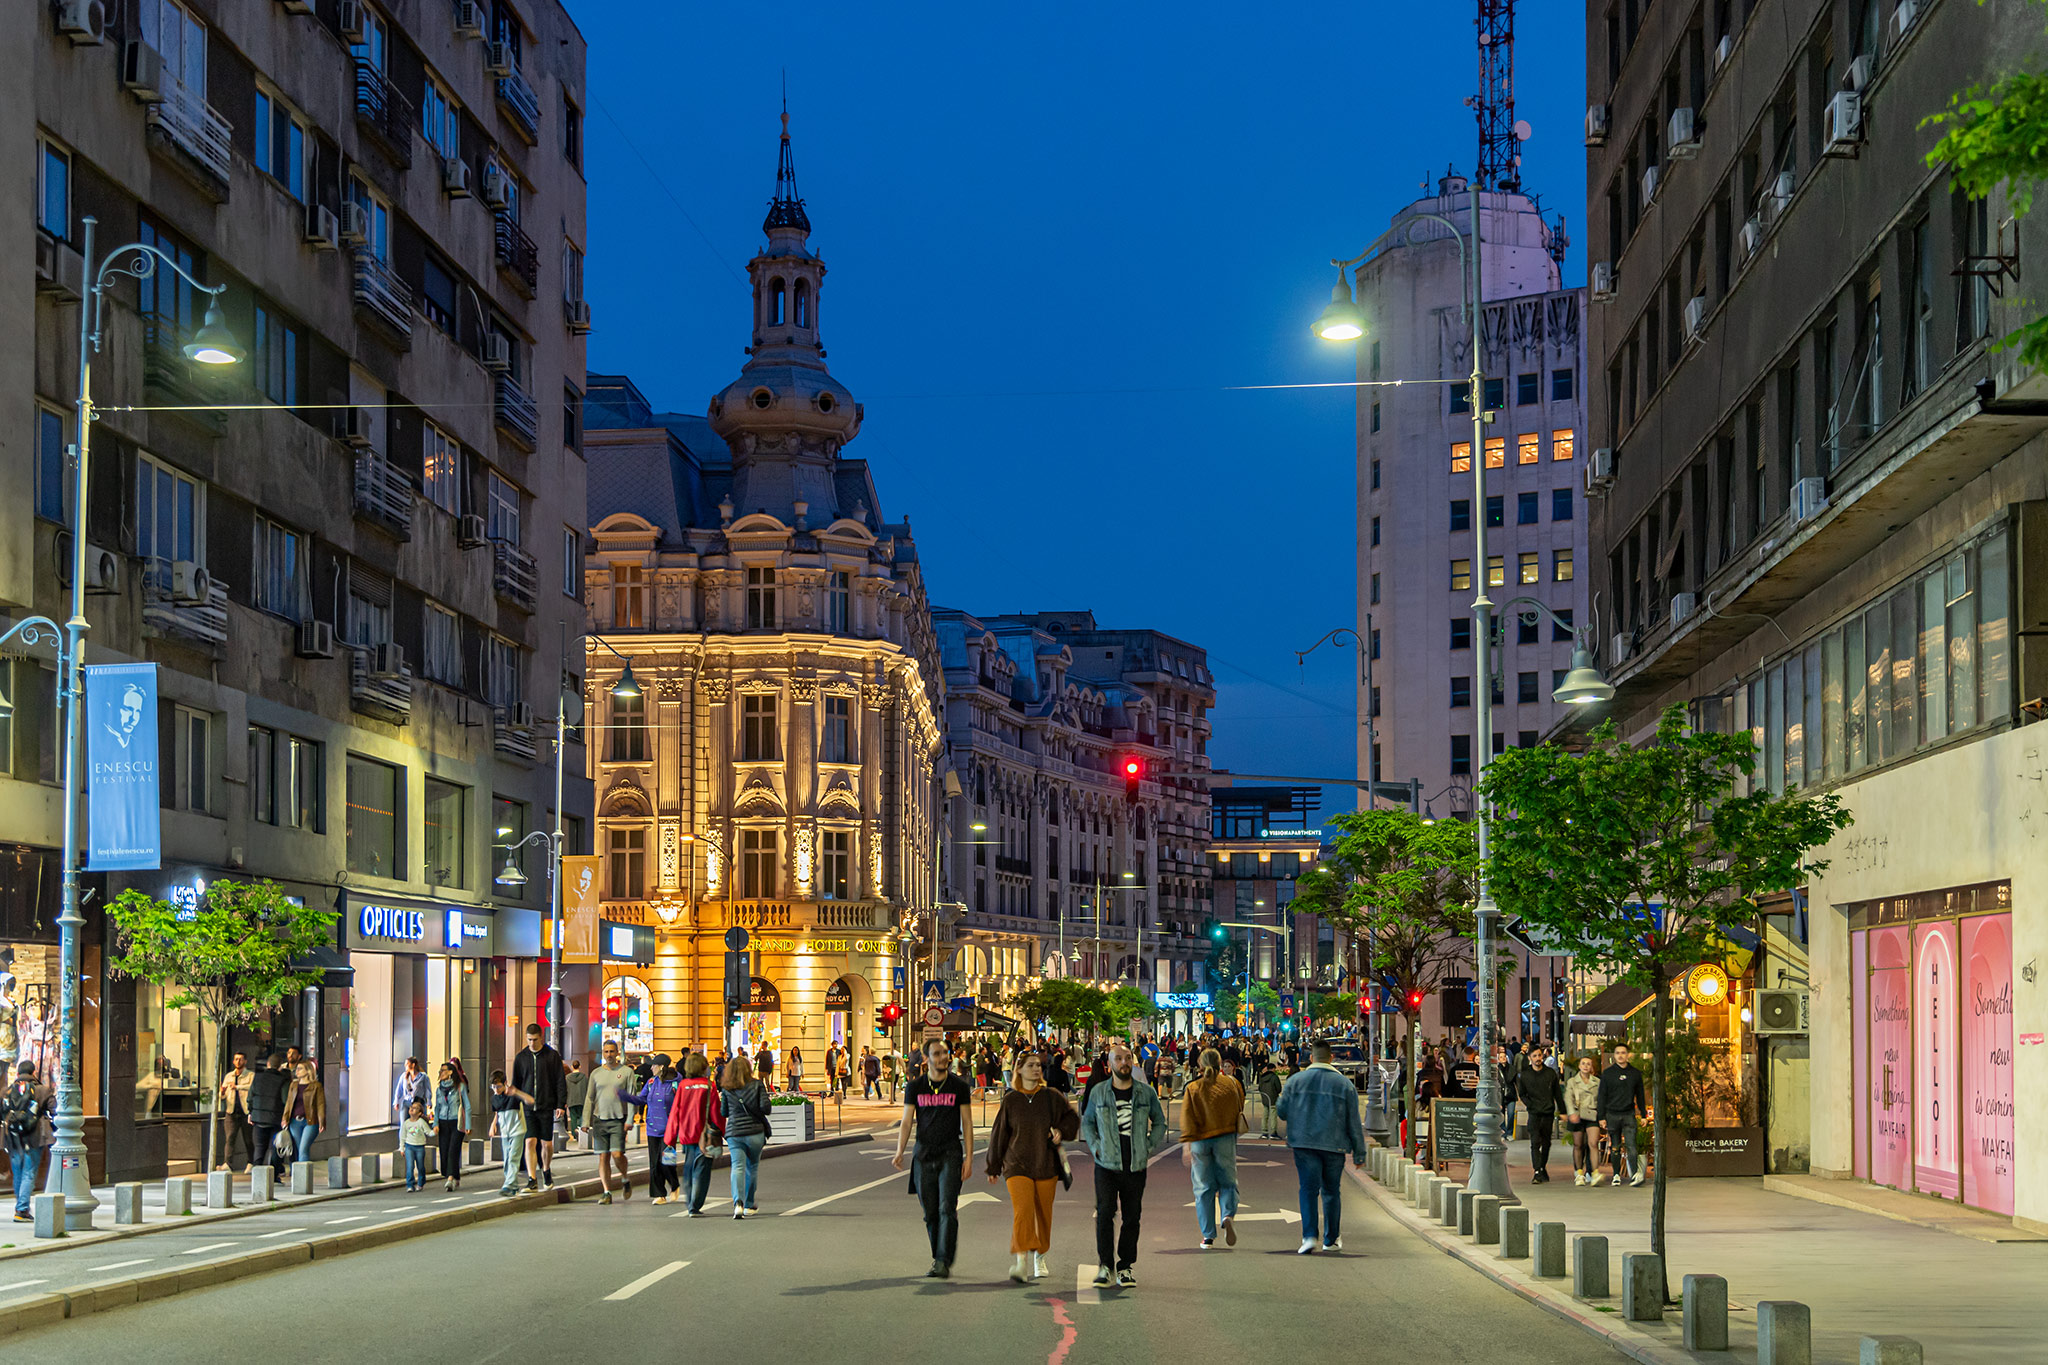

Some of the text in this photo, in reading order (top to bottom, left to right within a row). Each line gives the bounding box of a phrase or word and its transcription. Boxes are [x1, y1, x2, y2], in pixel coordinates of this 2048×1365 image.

[95, 761, 153, 774] ENESCU
[95, 775, 152, 784] FESTIVAL
[97, 848, 153, 858] festivalenescu.ro
[361, 905, 424, 940] OPTICLES
[746, 939, 795, 952] GRAND
[806, 939, 850, 952] HOTEL
[1696, 994, 1720, 1003] COFFEE
[1975, 981, 2013, 1017] Somethi
[1873, 994, 1909, 1030] Something
[1884, 1048, 1899, 1062] new
[1931, 963, 1940, 1155] HELLO!
[1989, 1047, 2011, 1066] new
[1873, 1081, 1880, 1102] is
[1975, 1090, 1983, 1114] is
[1878, 1119, 1906, 1140] MAYFAIR
[1719, 1139, 1749, 1147] BAKERY
[1981, 1136, 2014, 1161] MAYFAI
